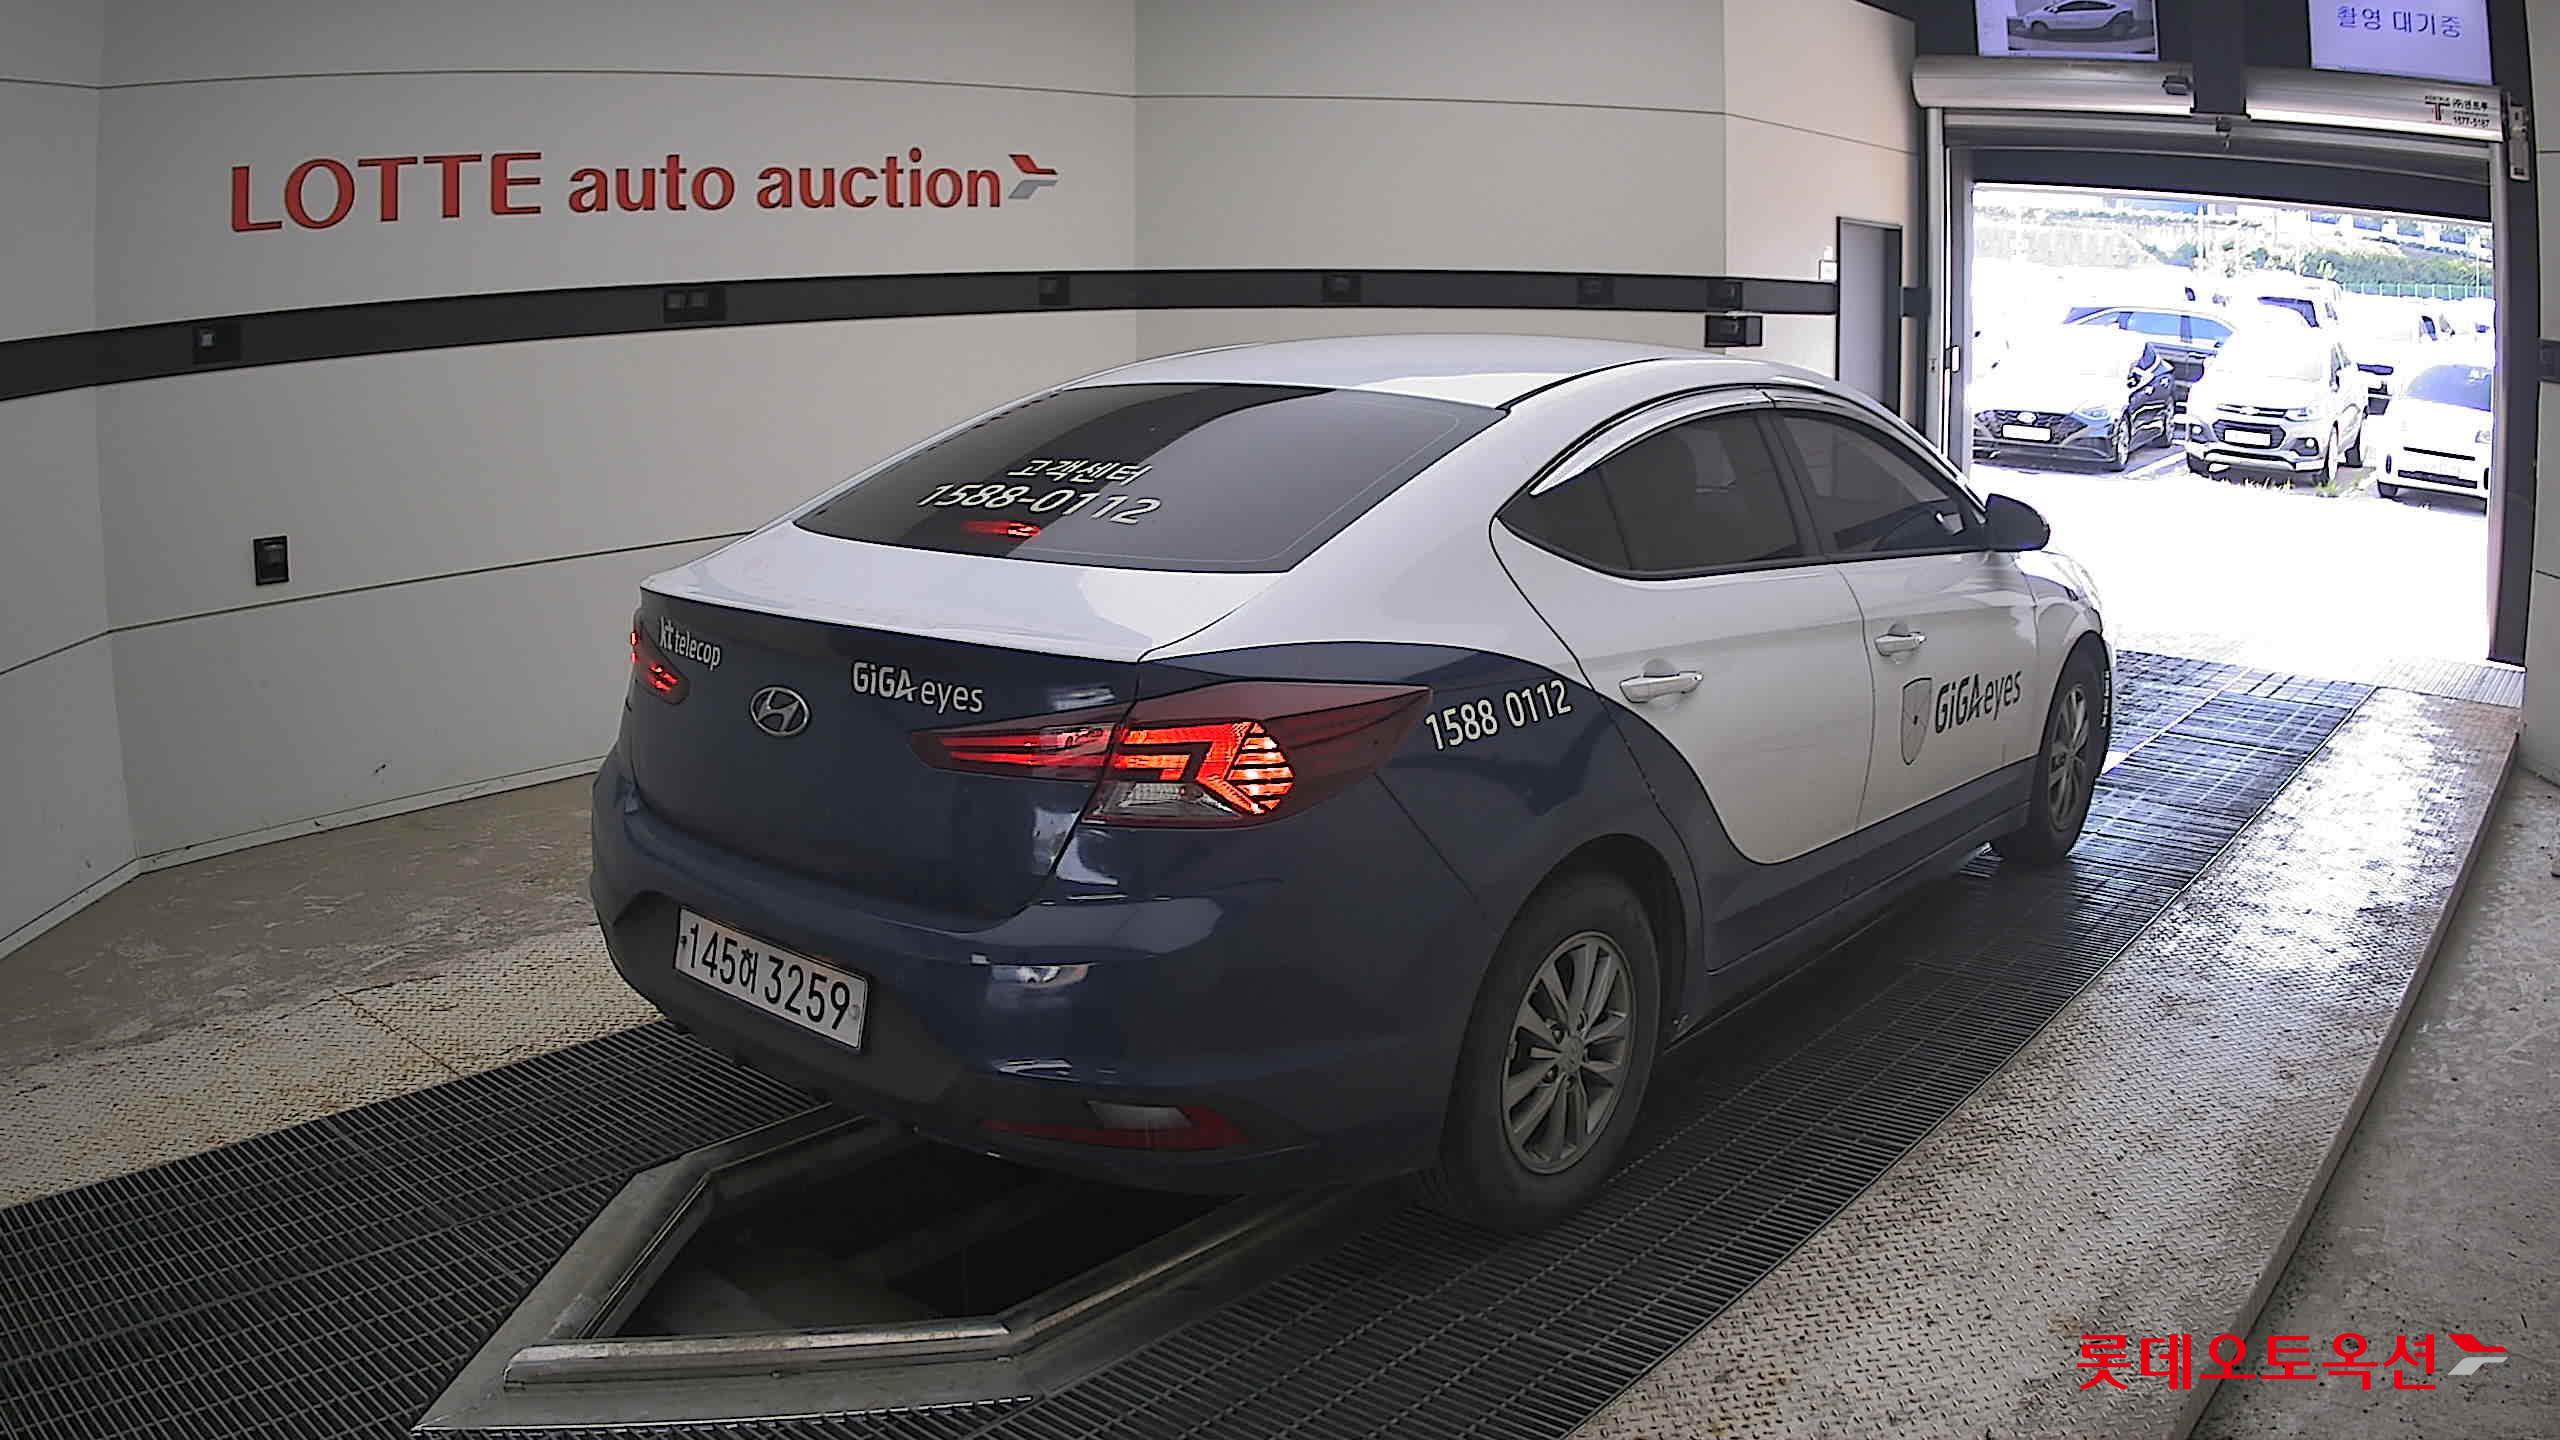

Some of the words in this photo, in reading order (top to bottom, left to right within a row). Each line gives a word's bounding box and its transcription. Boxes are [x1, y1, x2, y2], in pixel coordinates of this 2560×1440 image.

[2392, 11, 2461, 38] 대기중
[231, 152, 542, 233] LOTTE
[568, 154, 734, 212] auto
[756, 147, 1001, 208] auction
[1007, 459, 1152, 486] 고객센터
[917, 483, 1162, 525] 1588-0112
[674, 630, 721, 671] telecop
[920, 681, 984, 714] eyes
[1424, 699, 1498, 750] 1588
[1504, 679, 1572, 727] 0112
[1983, 670, 2023, 721] eyes
